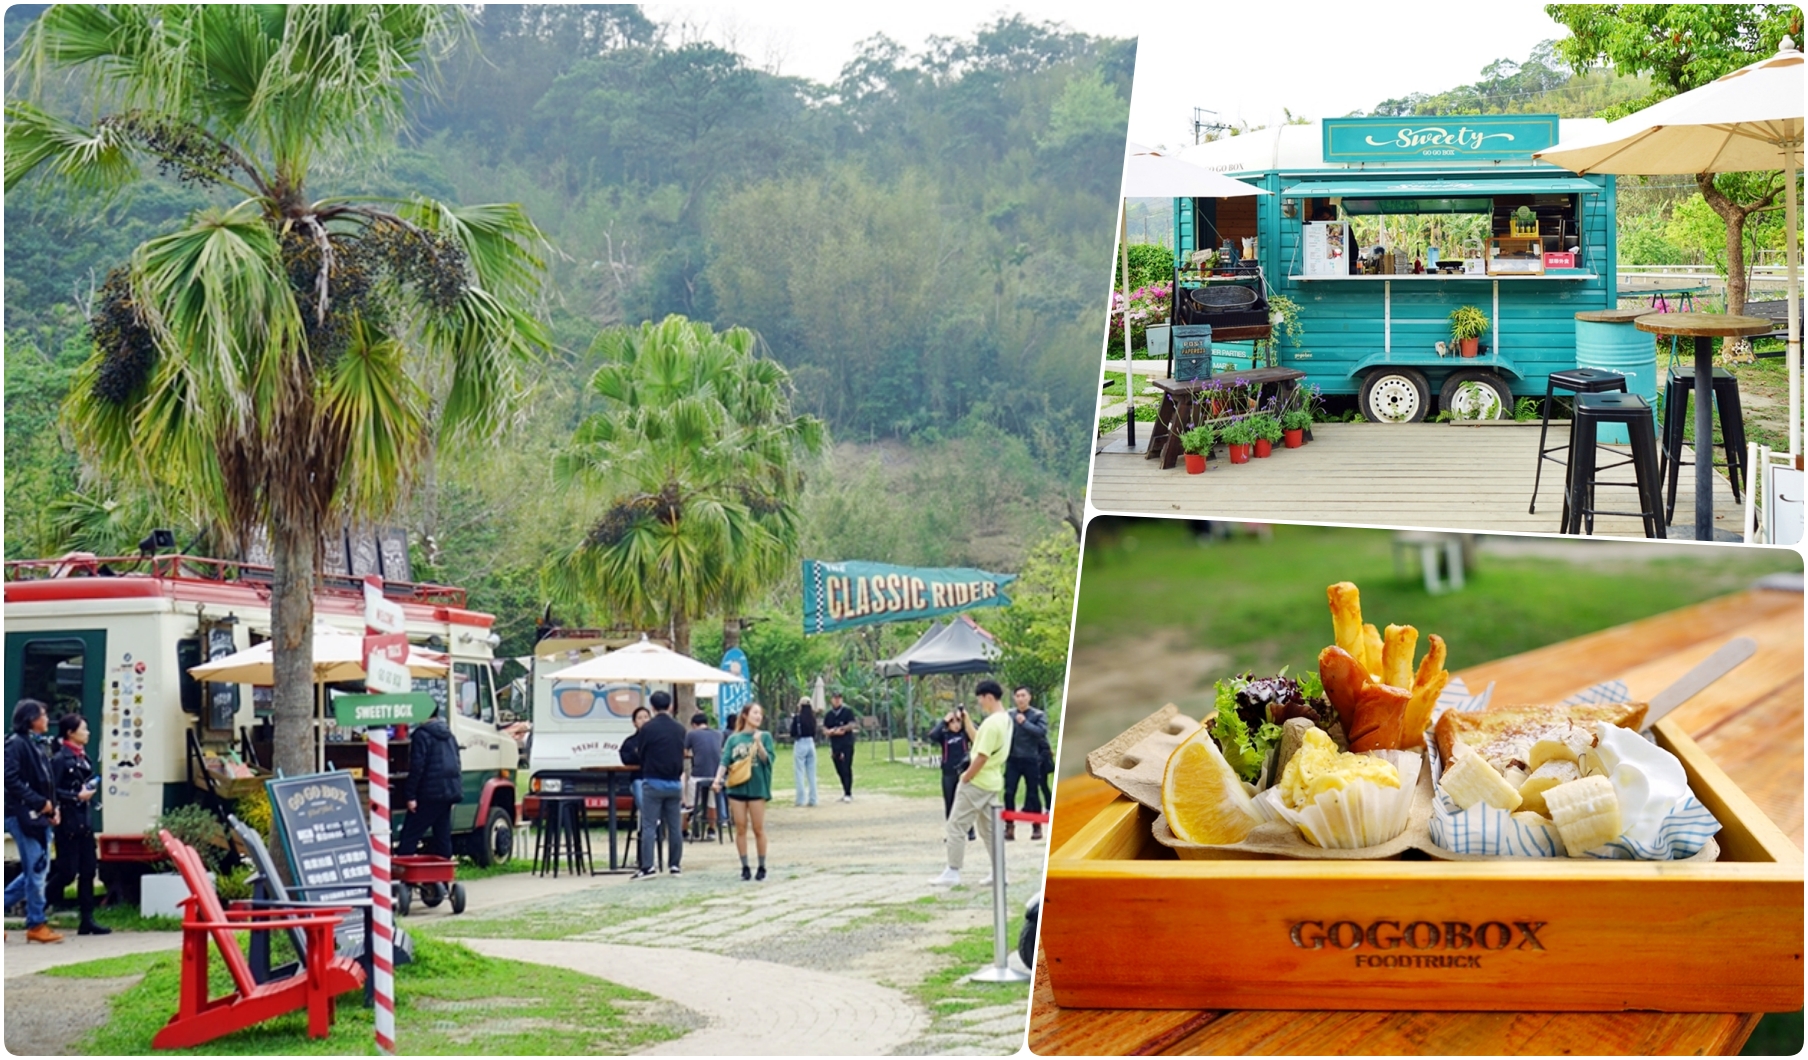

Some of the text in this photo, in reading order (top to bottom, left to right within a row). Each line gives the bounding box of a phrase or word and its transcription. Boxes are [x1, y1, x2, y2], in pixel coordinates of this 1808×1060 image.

[1366, 127, 1514, 149] Sweety
[1215, 165, 1227, 173] GO
[1228, 163, 1245, 172] BOX
[1221, 350, 1247, 358] PARTIES
[1213, 362, 1238, 370] MART
[826, 573, 1000, 621] CLASSIC RIDER
[722, 682, 748, 704] LIVE
[355, 704, 413, 719] SWEETY BOX
[571, 742, 599, 755] MINI
[602, 742, 621, 752] BO
[320, 784, 349, 806] BOX
[1289, 920, 1548, 951] GOGOBOX
[1355, 955, 1482, 968] FOODTRUCK
